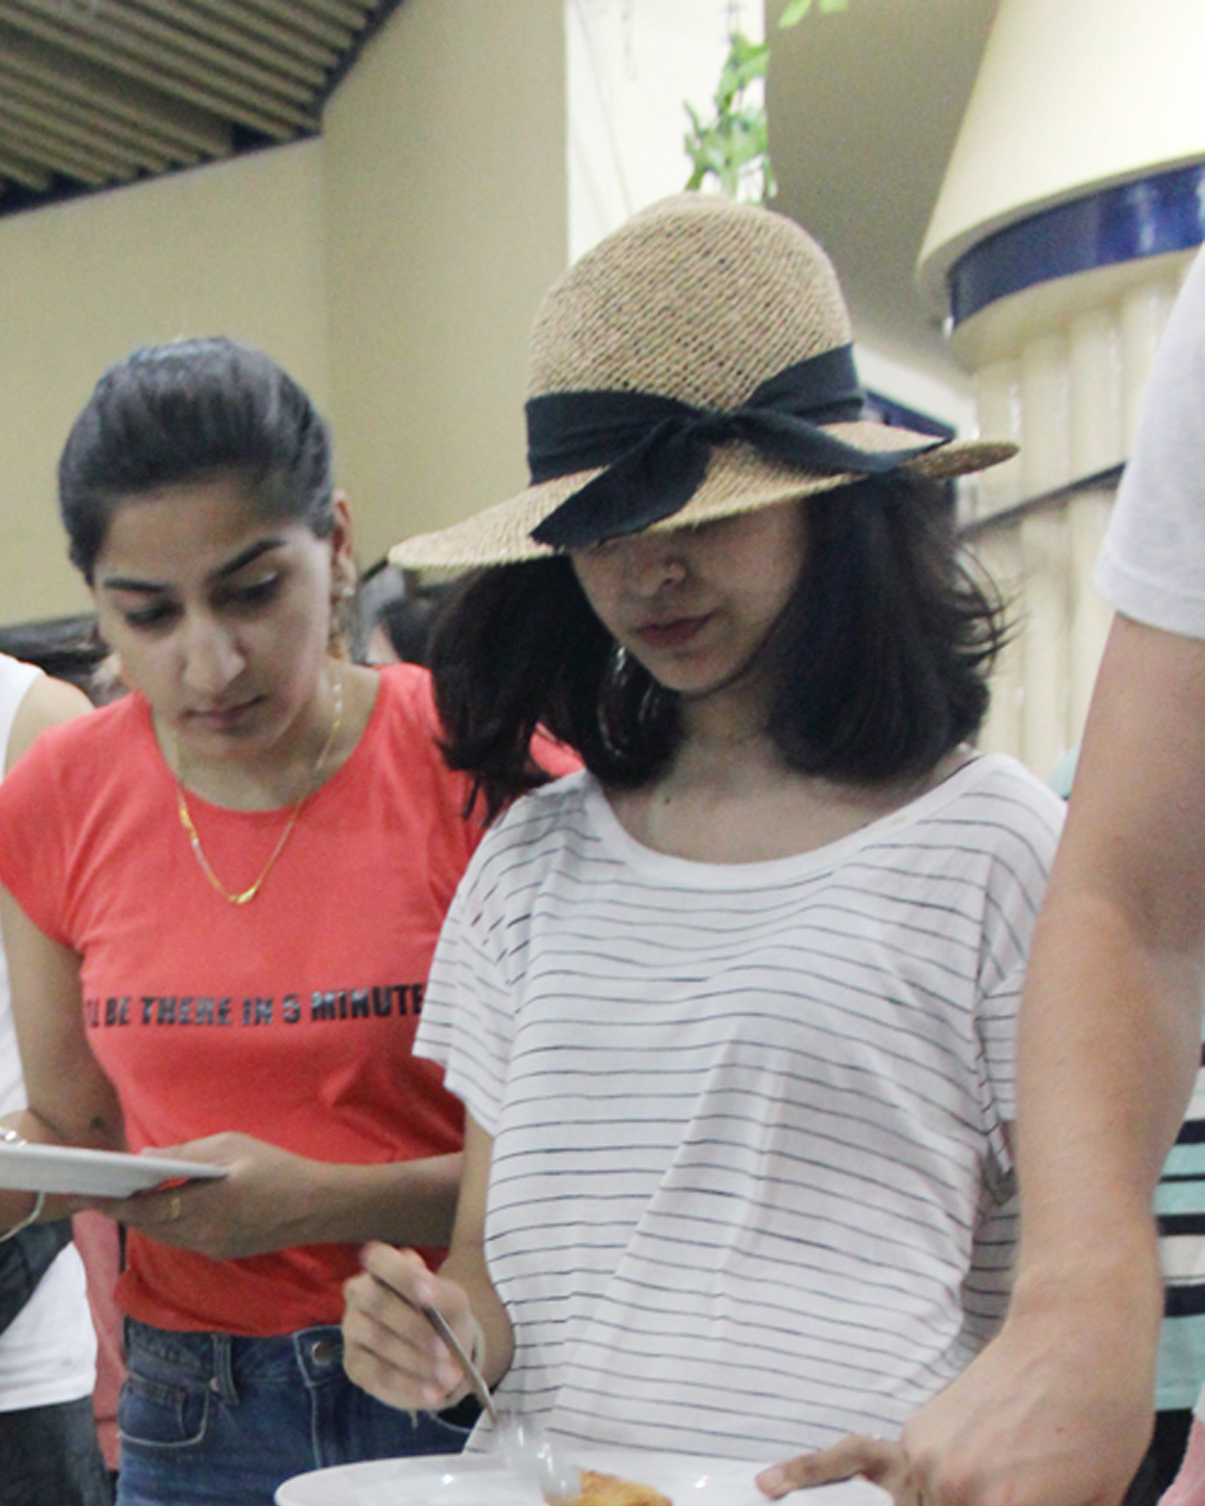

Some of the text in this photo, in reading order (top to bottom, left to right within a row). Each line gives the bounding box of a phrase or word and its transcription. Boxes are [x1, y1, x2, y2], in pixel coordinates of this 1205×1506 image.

[104, 996, 131, 1026] BE
[141, 995, 232, 1025] THERE
[242, 996, 273, 1026] IN
[282, 993, 301, 1024] 5
